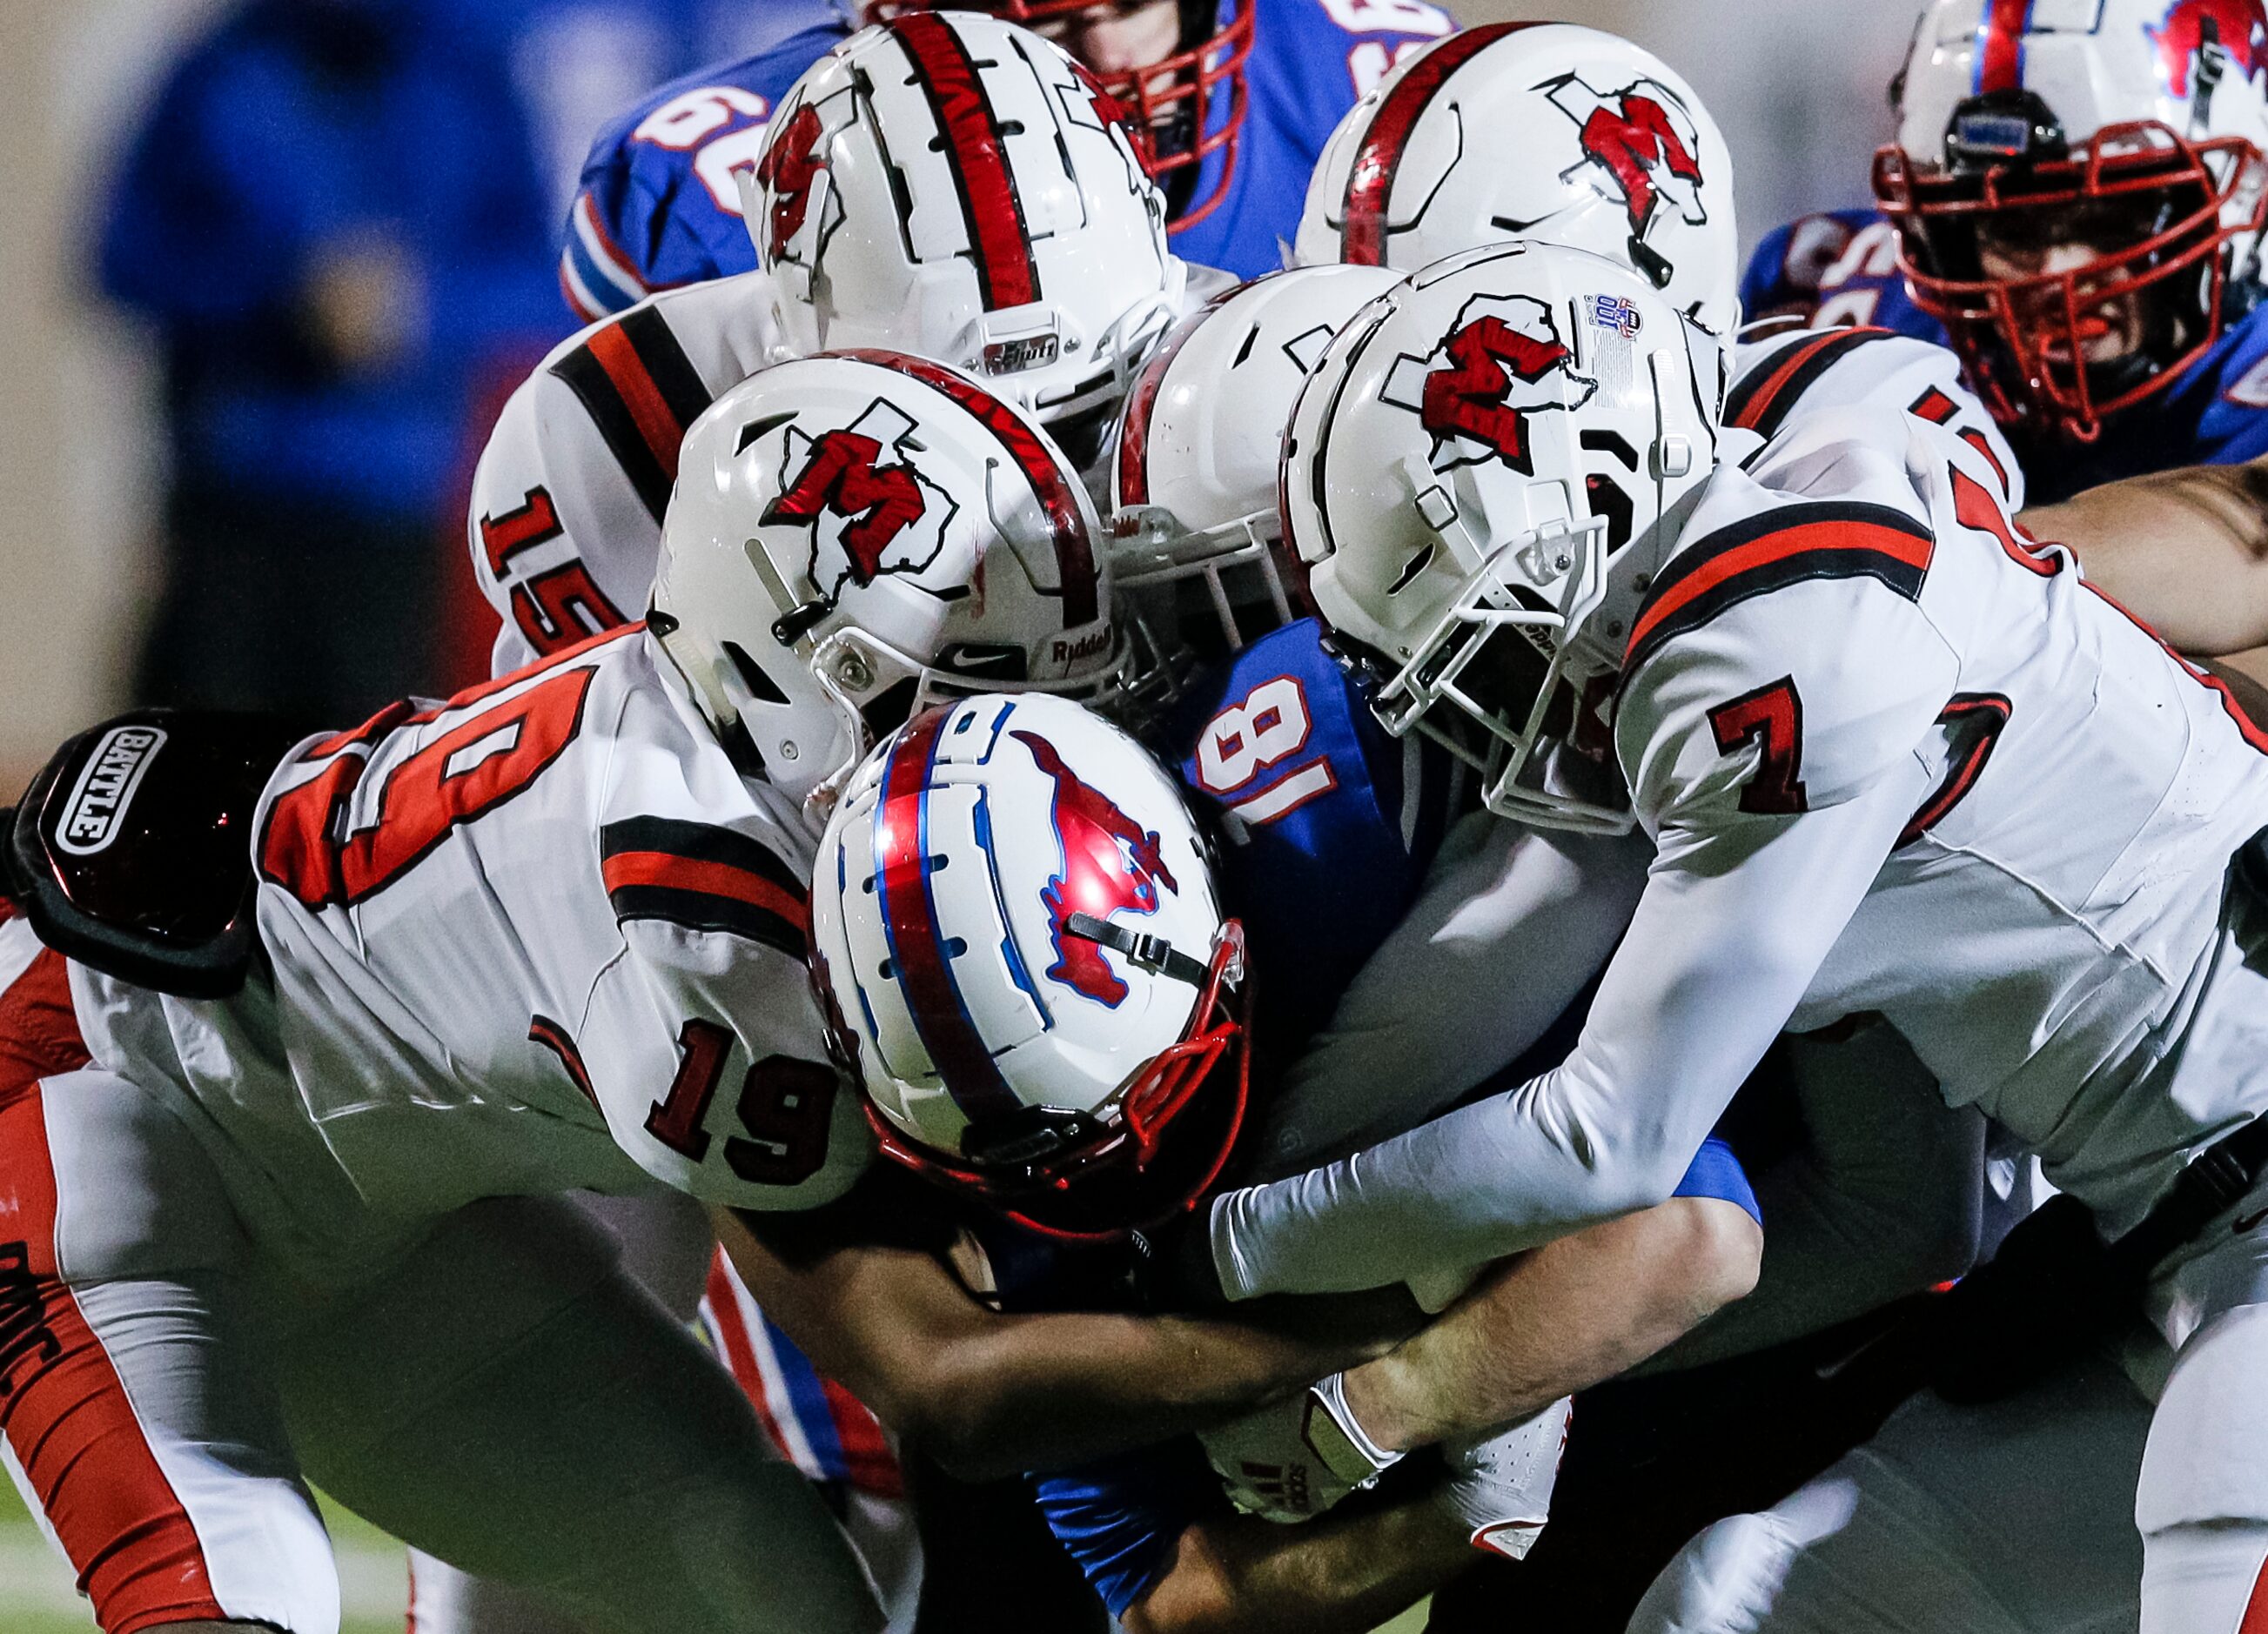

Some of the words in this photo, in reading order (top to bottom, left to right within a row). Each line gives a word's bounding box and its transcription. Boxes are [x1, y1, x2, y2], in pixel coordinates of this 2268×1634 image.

[480, 486, 628, 658] 15
[68, 732, 154, 839] BATTLE
[1707, 673, 1809, 814] 7
[644, 1017, 841, 1186] 19
